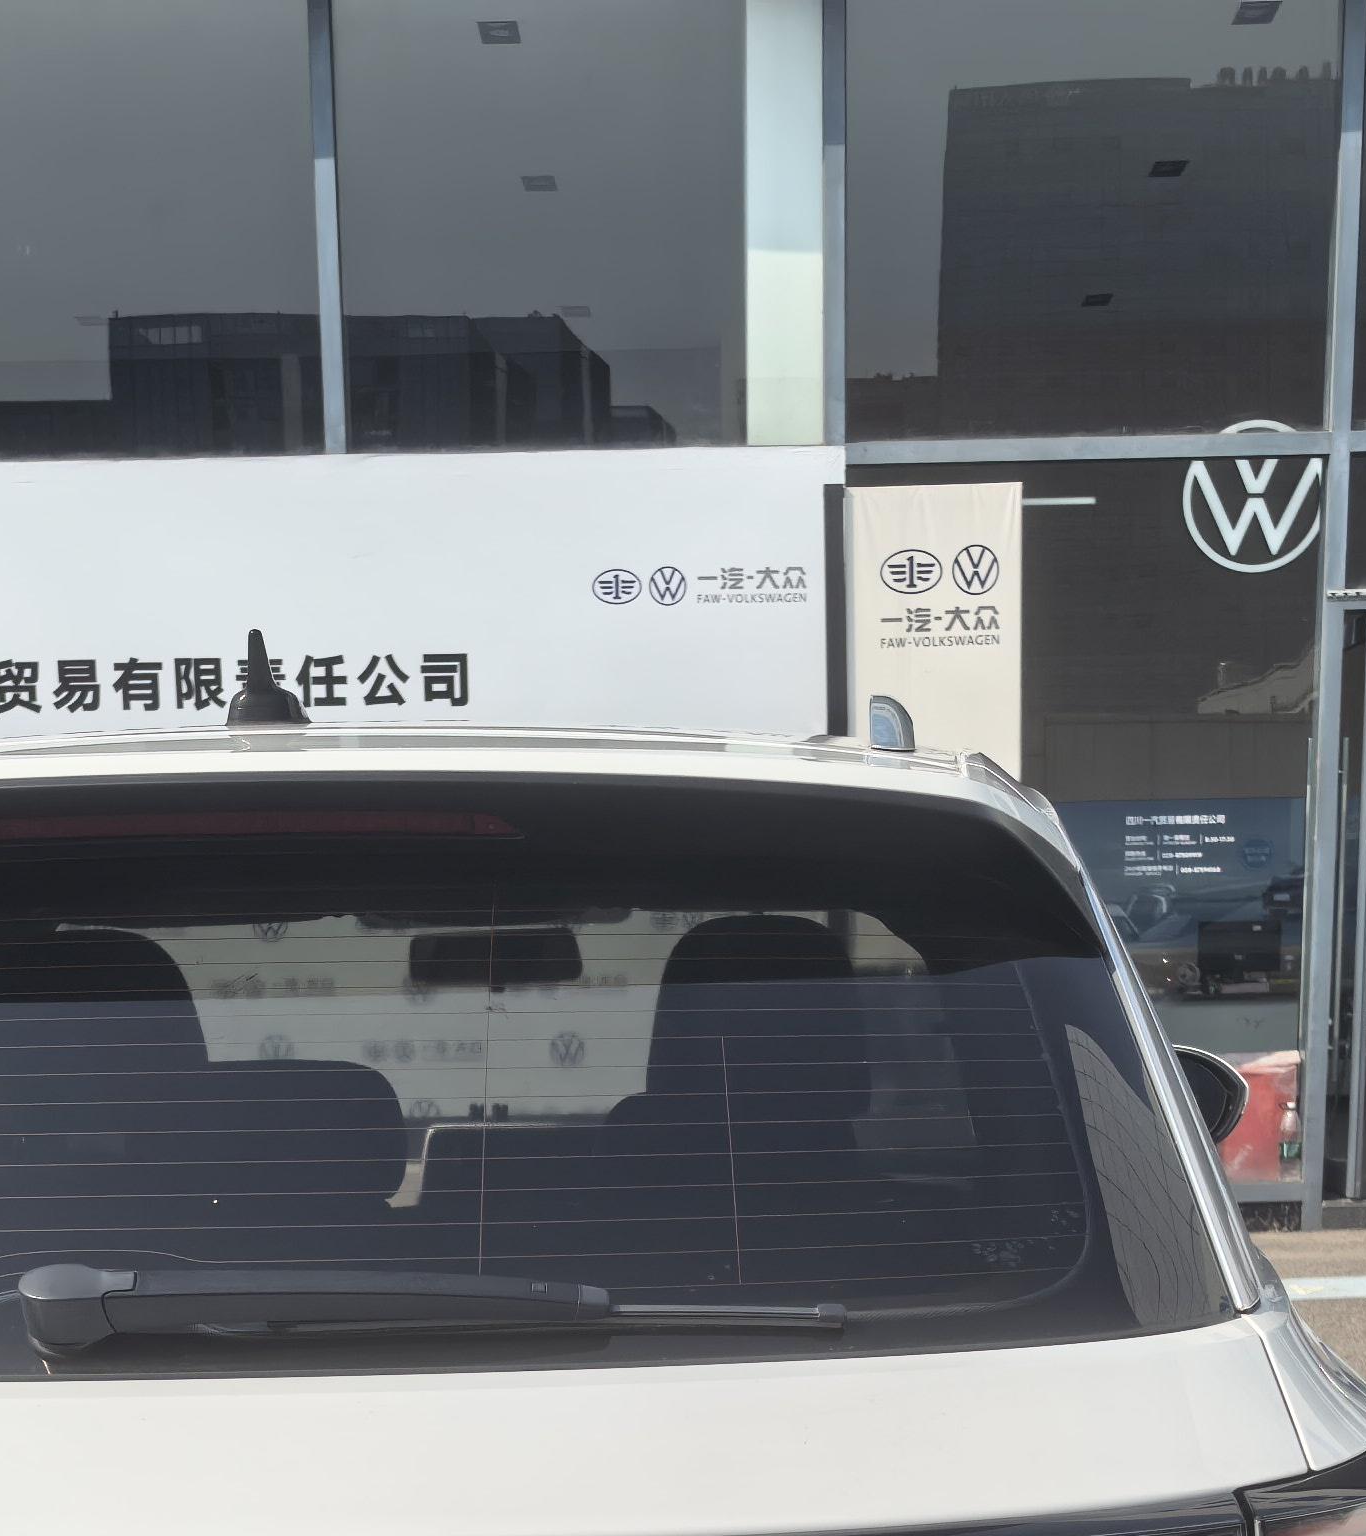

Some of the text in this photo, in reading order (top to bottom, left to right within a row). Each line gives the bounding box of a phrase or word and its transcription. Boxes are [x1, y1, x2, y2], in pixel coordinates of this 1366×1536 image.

[697, 566, 807, 590] 一汽-大众
[696, 592, 808, 604] FAW-VOLKSWAGEN
[880, 605, 1001, 633] 一汽-大众
[880, 634, 1001, 649] FAW-VOLKSWAGEN
